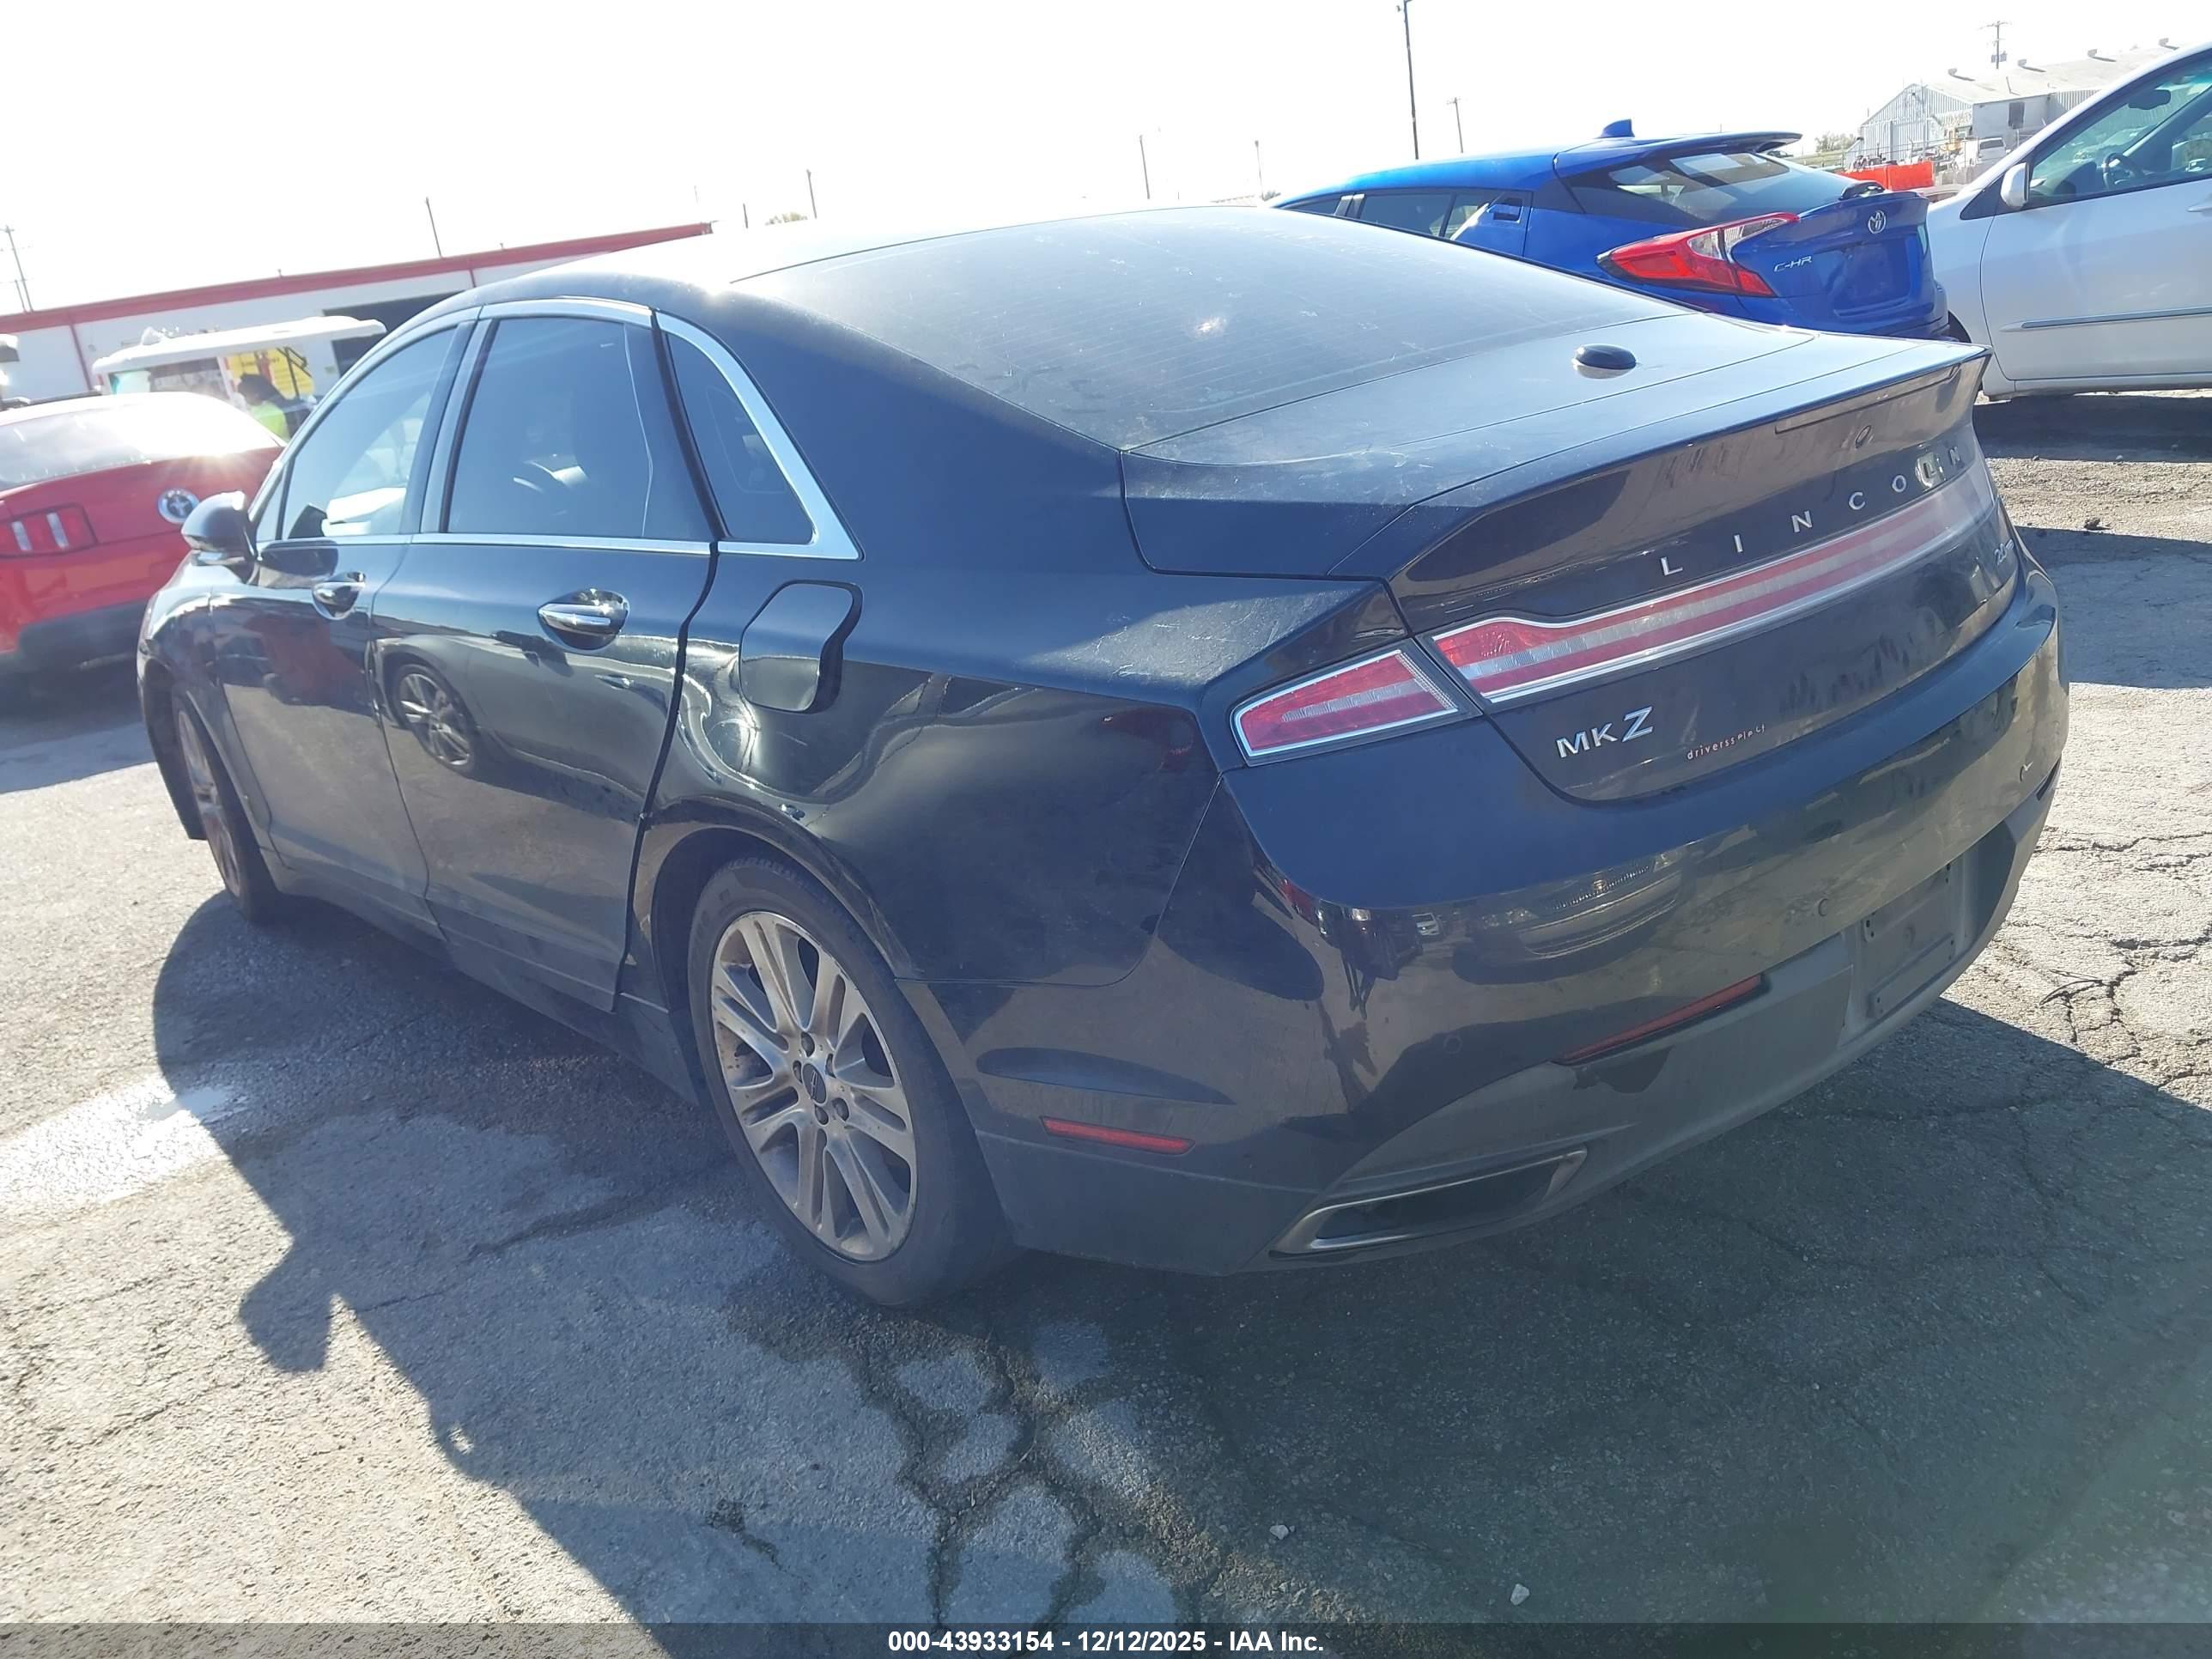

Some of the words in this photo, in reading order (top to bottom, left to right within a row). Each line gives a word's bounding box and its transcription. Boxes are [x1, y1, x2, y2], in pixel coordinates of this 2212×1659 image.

[1773, 255, 1812, 272] C-HR
[1660, 446, 1962, 577] LINCOLN
[1555, 706, 1654, 758] MKZ
